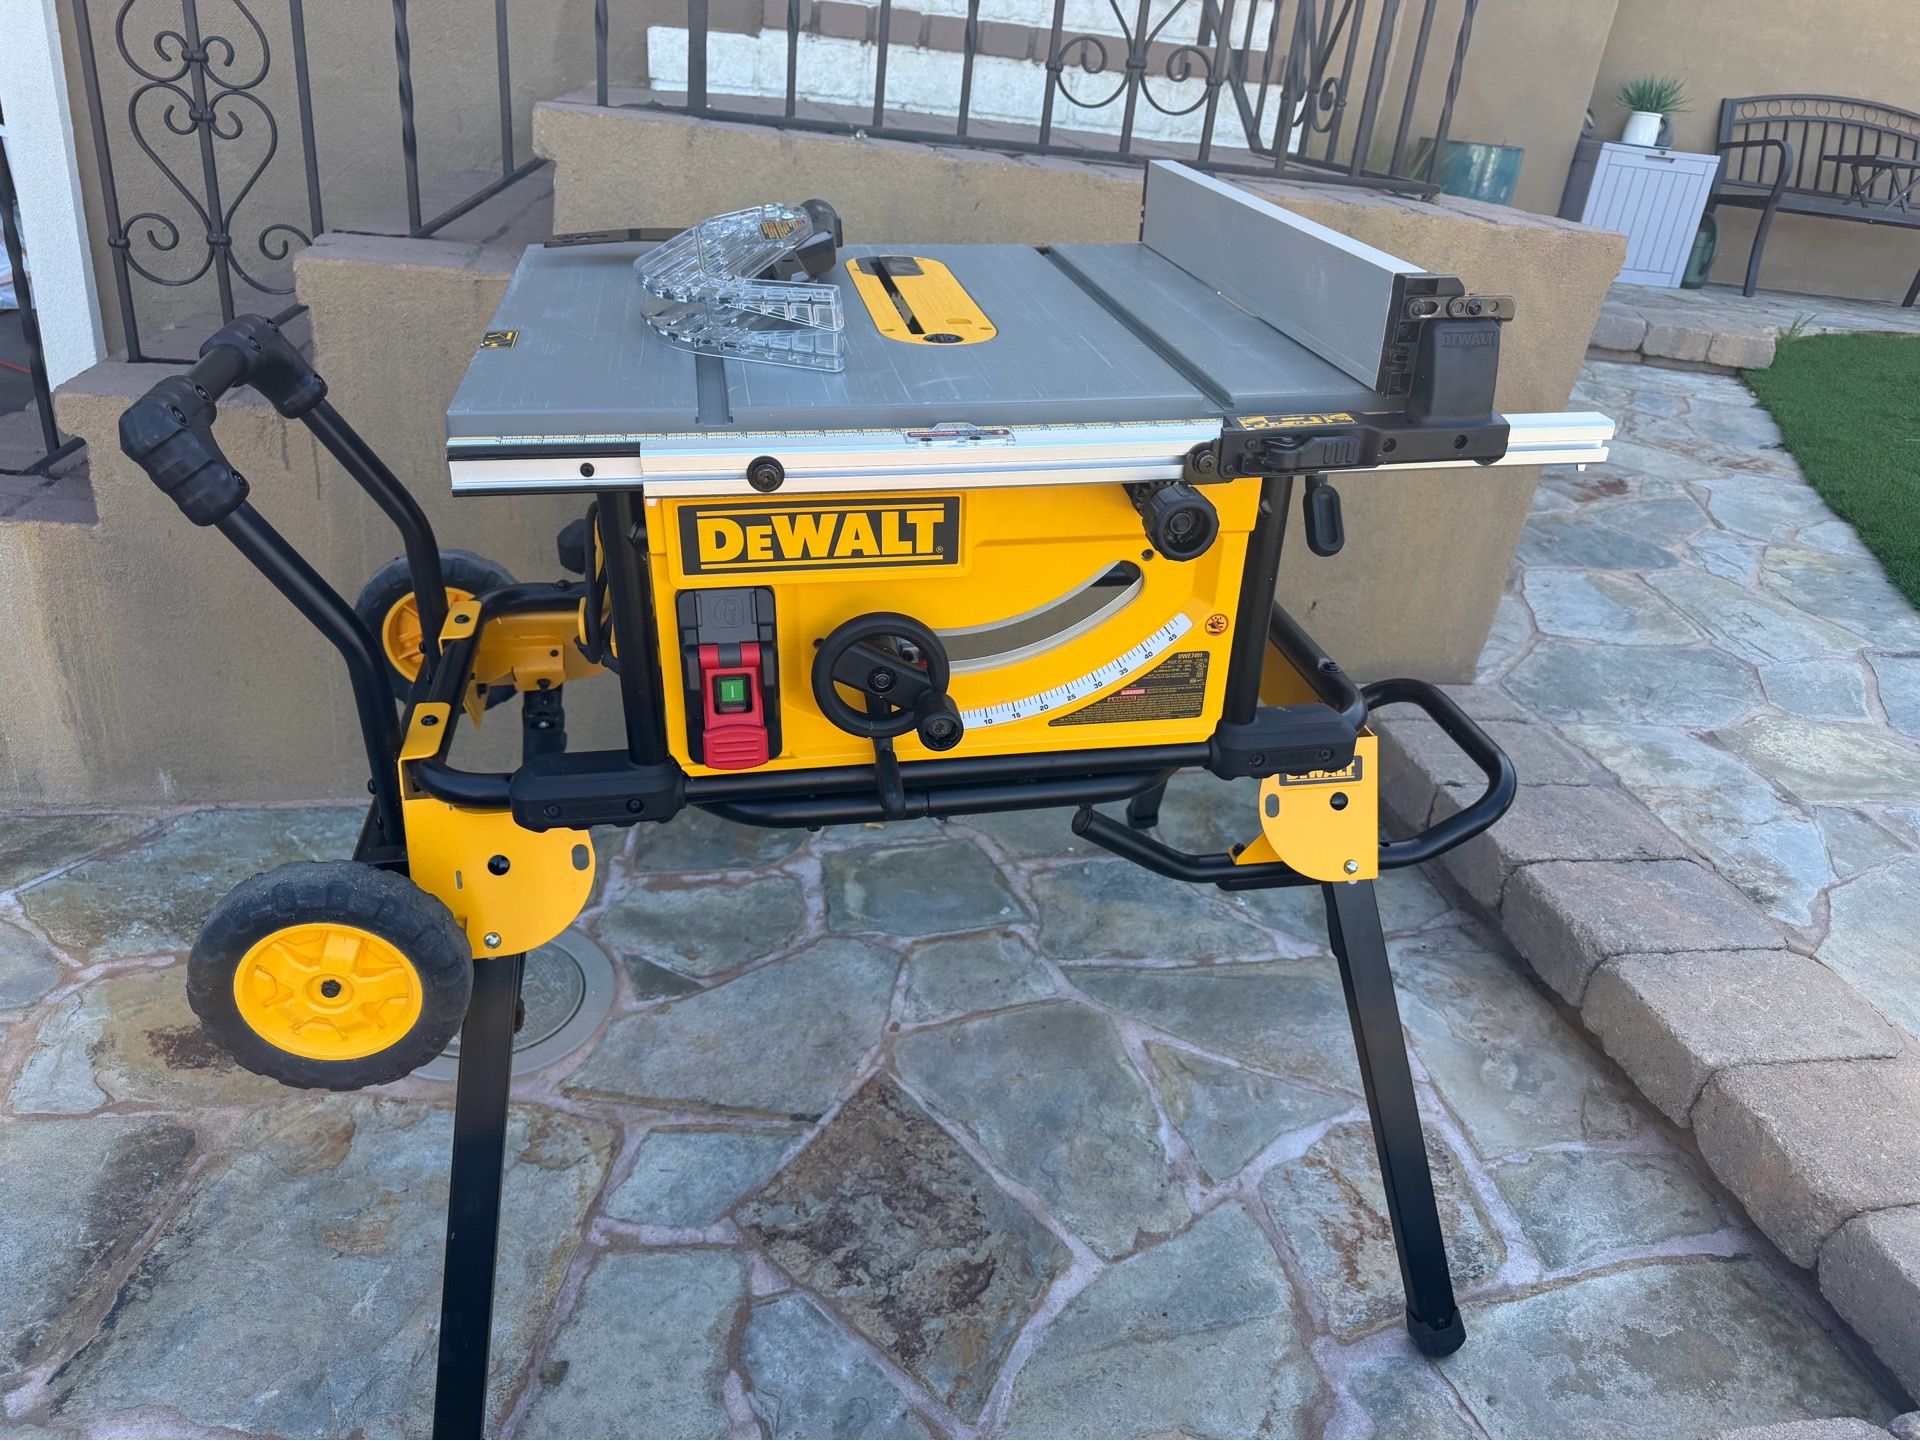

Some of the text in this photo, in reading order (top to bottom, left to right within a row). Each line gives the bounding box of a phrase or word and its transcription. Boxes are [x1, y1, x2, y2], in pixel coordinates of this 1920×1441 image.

[1168, 633, 1178, 642] 45
[1144, 651, 1154, 660] 40
[1119, 667, 1129, 676] 35
[1093, 680, 1103, 690] 30
[1066, 693, 1077, 702] 25
[1039, 703, 1049, 711] 20
